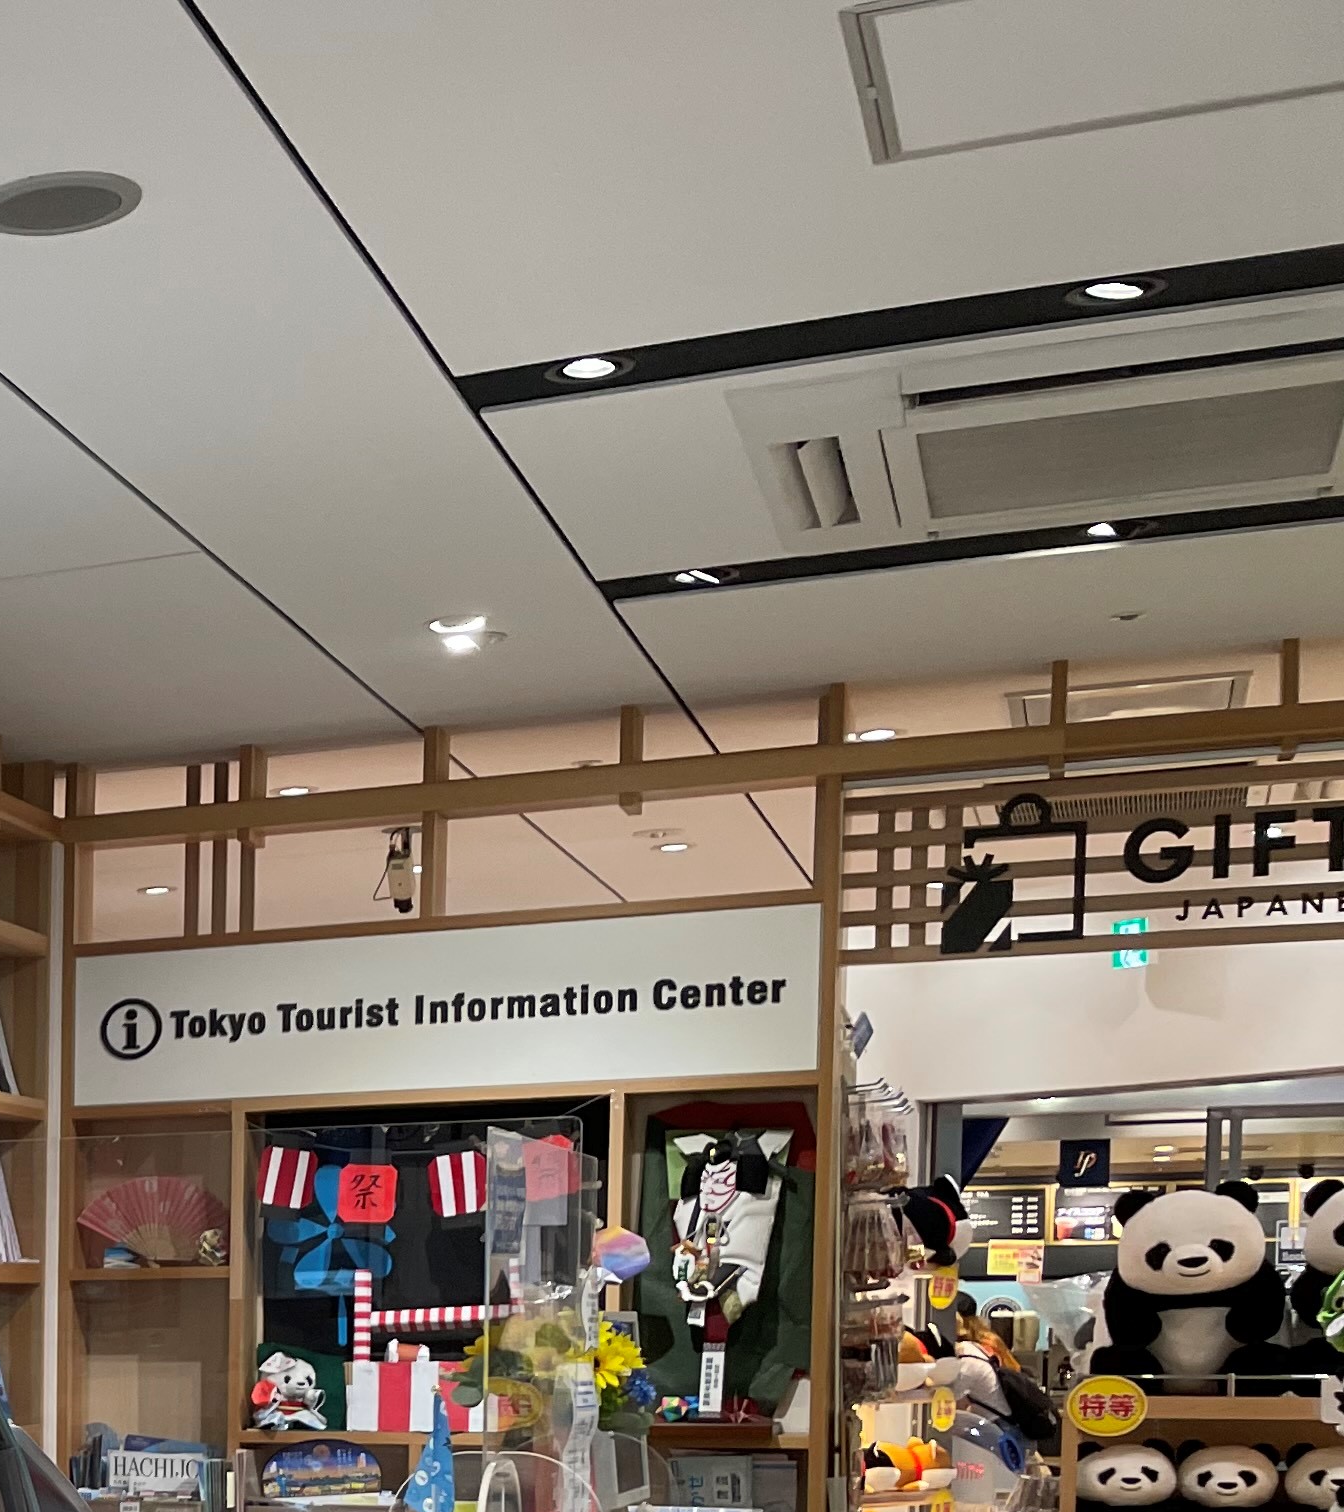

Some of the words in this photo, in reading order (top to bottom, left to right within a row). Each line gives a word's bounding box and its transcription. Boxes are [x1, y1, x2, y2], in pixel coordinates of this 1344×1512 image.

[170, 1008, 266, 1043] Tokyo
[277, 998, 399, 1033] Tourist
[414, 983, 638, 1026] Information
[652, 974, 786, 1012] Center
[1078, 1393, 1136, 1420] 特等
